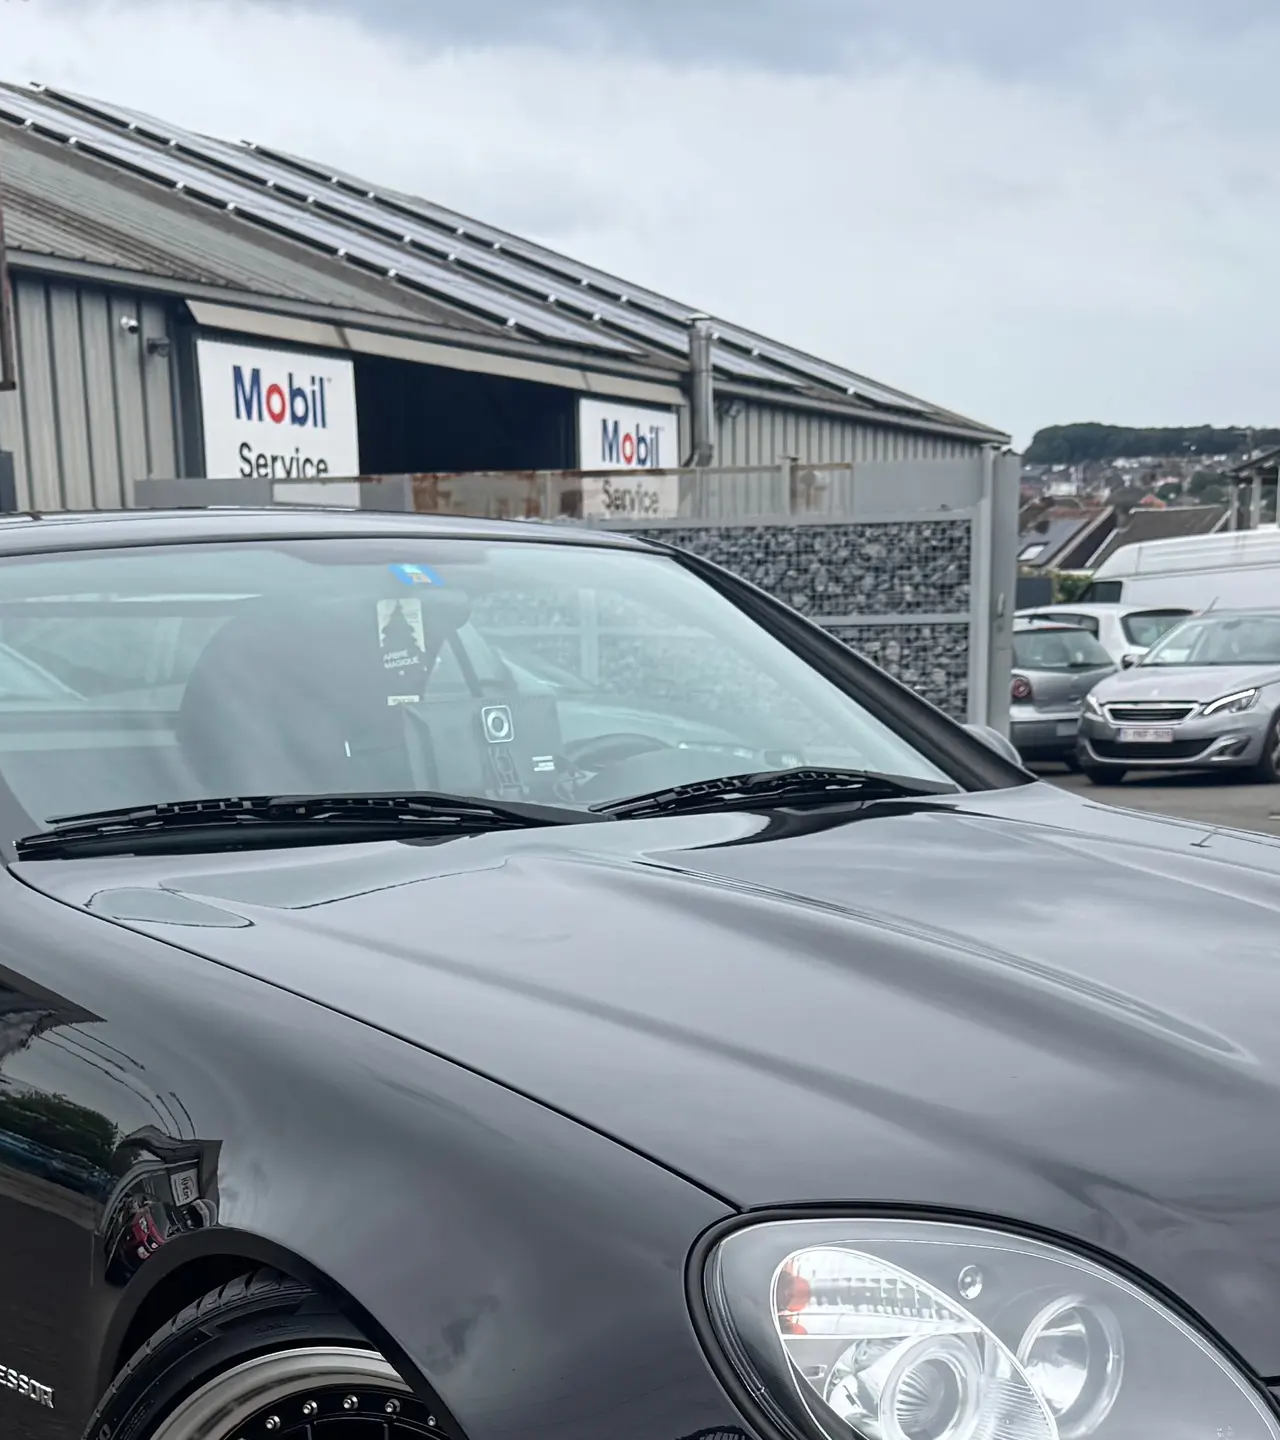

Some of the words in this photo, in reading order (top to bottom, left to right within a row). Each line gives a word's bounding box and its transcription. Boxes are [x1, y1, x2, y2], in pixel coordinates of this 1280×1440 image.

[233, 365, 327, 428] Mobil
[239, 441, 329, 479] Service
[601, 418, 660, 466] Mobil
[602, 479, 660, 514] Service
